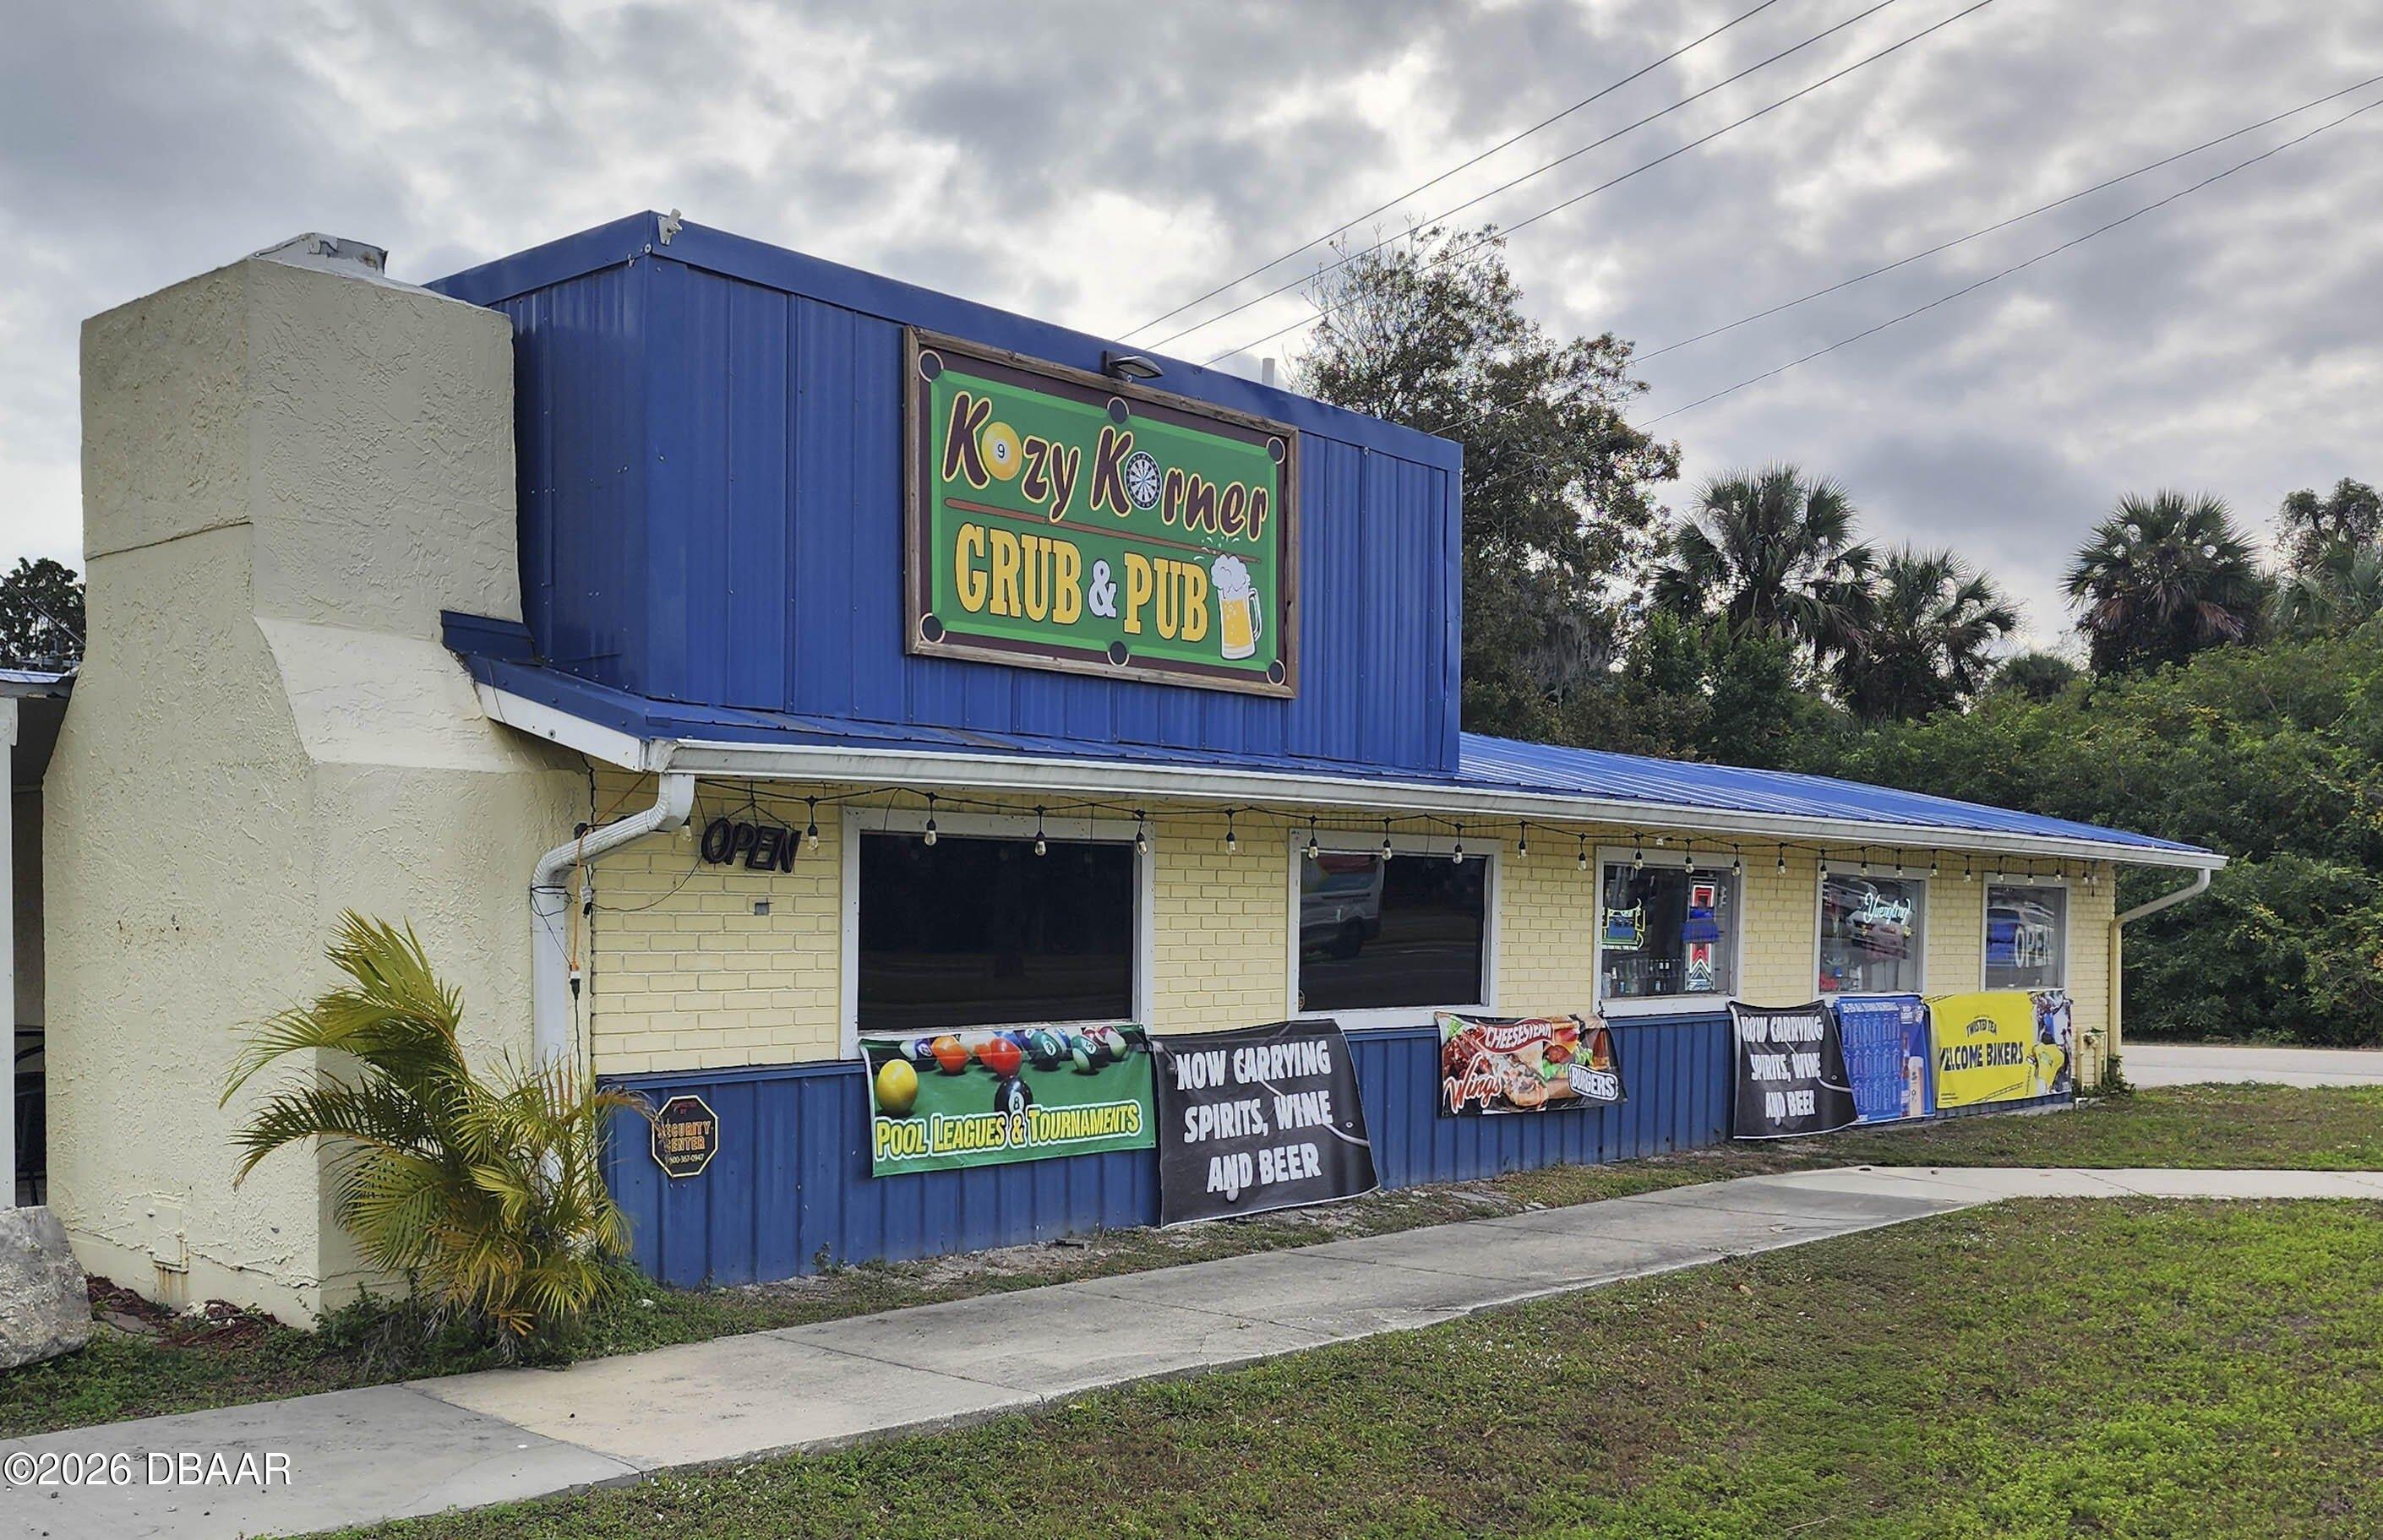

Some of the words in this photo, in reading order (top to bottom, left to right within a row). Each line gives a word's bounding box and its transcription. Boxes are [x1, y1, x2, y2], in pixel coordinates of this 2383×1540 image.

[955, 522, 1082, 623] GRUB
[1088, 558, 1117, 618] &
[1123, 552, 1208, 642] PUB
[701, 818, 801, 873] OPEN
[1740, 1016, 1768, 1043] NOW
[1770, 1015, 1824, 1042] CARRYING
[1986, 1041, 2024, 1066] BIKERS
[1175, 1049, 1226, 1091] NOW
[1233, 1040, 1332, 1084] CARRYING
[1443, 1055, 1502, 1114] Wings
[1571, 1066, 1616, 1098] BURGERS
[1010, 1114, 1025, 1144] &
[1184, 1098, 1268, 1143] SPIRITS,
[1273, 1090, 1333, 1130] WINE
[1765, 1091, 1786, 1118] AND
[1786, 1090, 1816, 1115] BEER
[1207, 1151, 1254, 1193] AND
[1258, 1142, 1322, 1184] BEER
